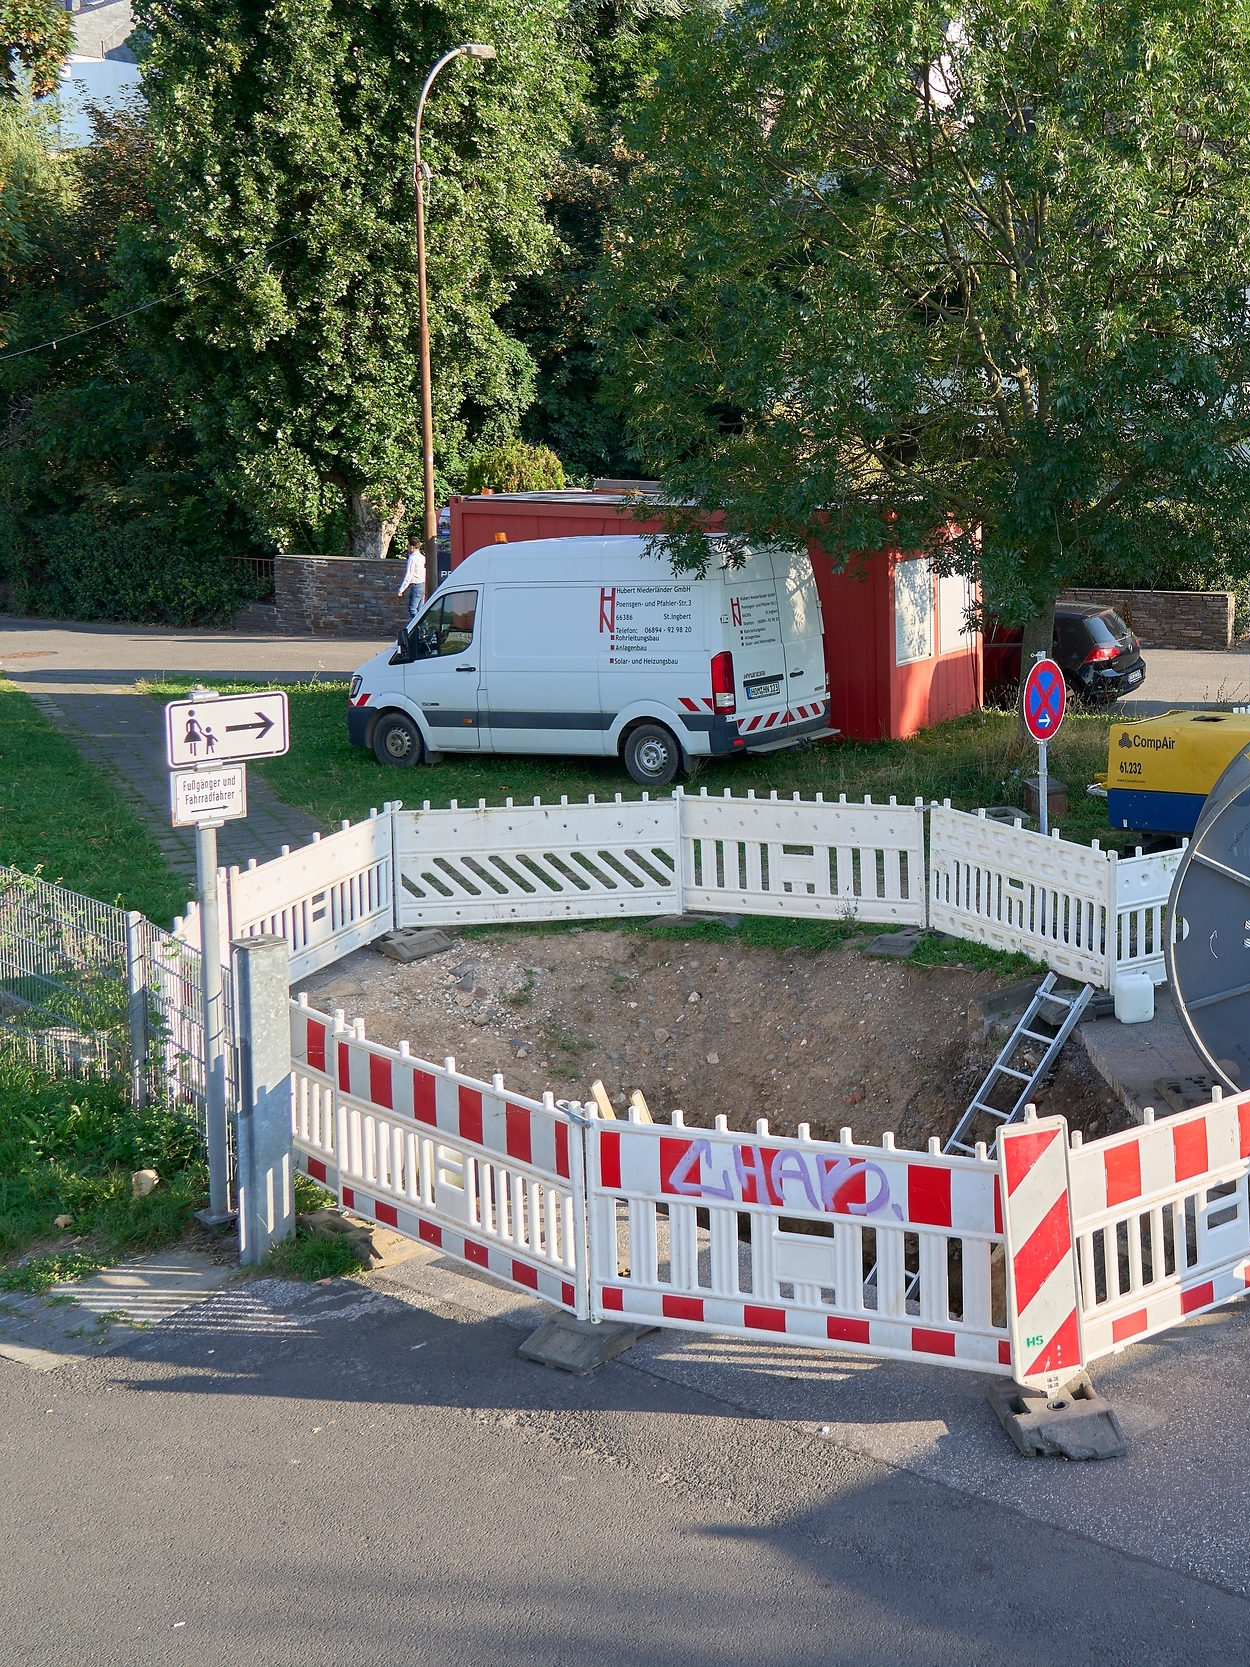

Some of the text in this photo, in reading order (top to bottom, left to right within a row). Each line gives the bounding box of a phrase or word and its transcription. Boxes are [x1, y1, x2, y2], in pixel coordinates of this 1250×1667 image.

[644, 626, 662, 634] 06894
[615, 634, 660, 642] Rohrleitungsbau
[615, 644, 647, 652] Anlagenbau
[643, 658, 679, 666] Heizungsbau
[744, 671, 765, 679] HYUNDAI
[1133, 734, 1176, 751] CompAir
[1119, 761, 1142, 775] 61.232
[183, 775, 236, 792] Fußgänger und
[185, 790, 235, 805] Fahrradfahrer
[1026, 1335, 1044, 1348] HS
